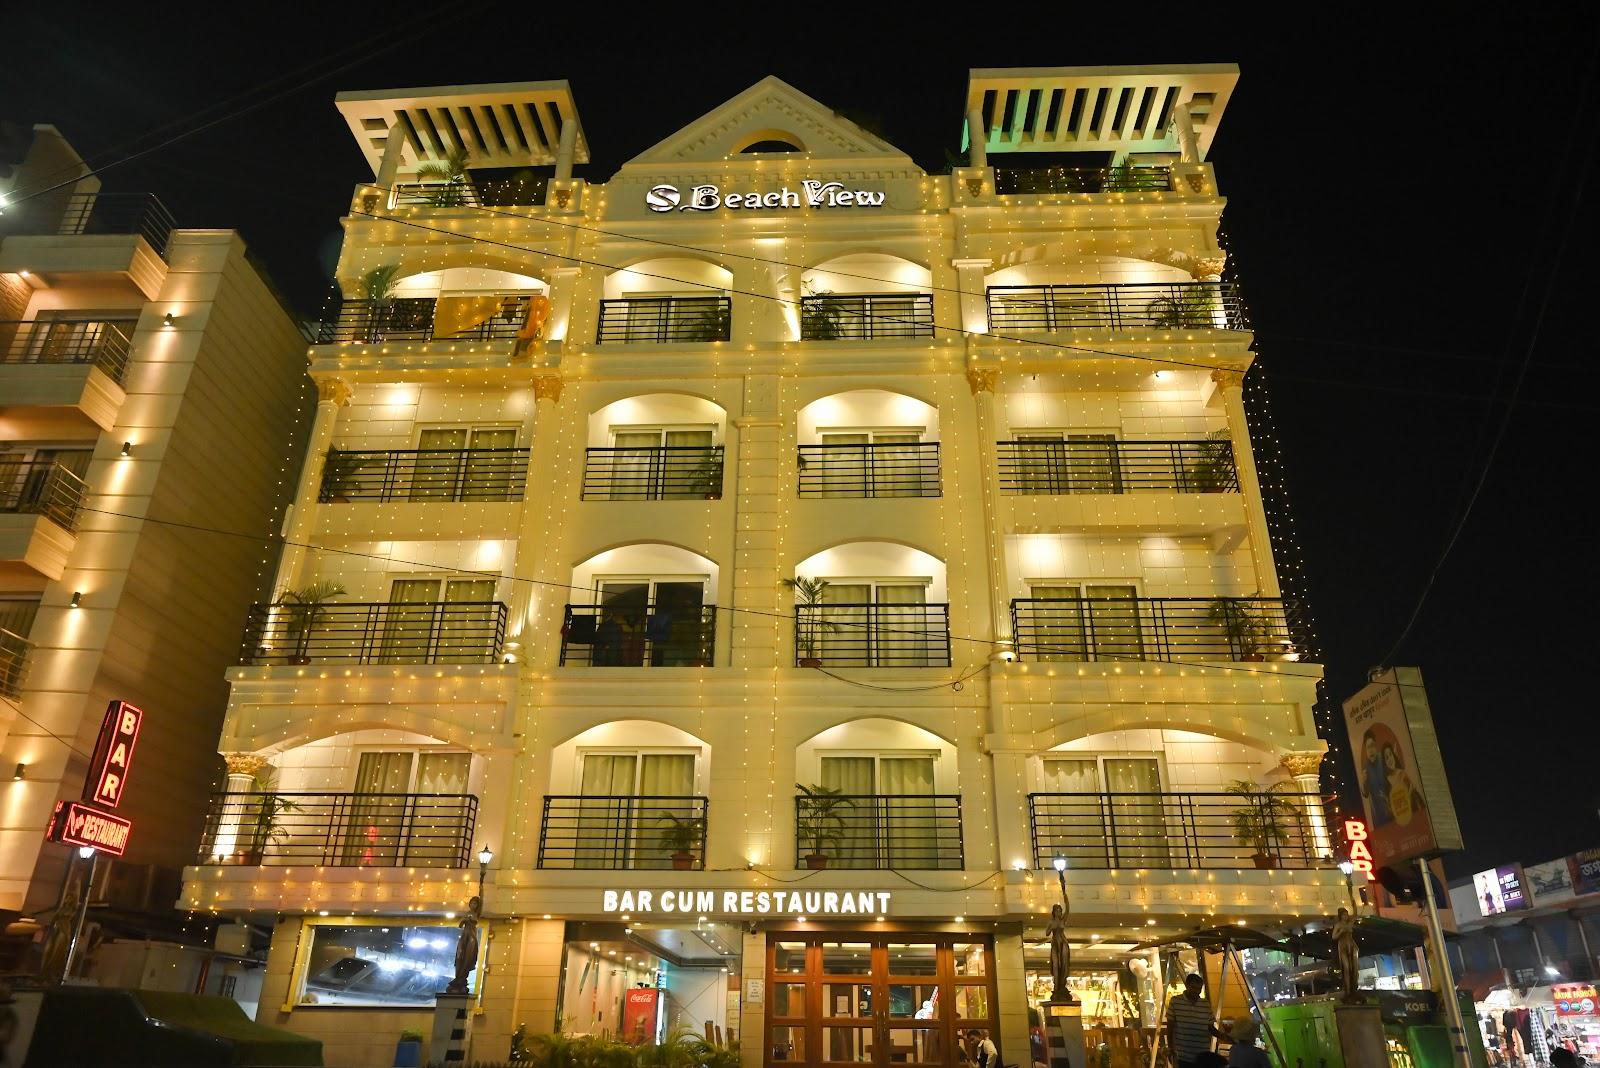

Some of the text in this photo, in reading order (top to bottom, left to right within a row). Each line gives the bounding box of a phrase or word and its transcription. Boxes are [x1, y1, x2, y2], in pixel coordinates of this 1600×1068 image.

[679, 184, 801, 212] Beach
[802, 180, 886, 210] View
[101, 710, 137, 800] BAR
[81, 814, 129, 849] RESTAURANT
[1344, 820, 1376, 881] BAR
[603, 890, 891, 914] BAR CUM RESTAURANT
